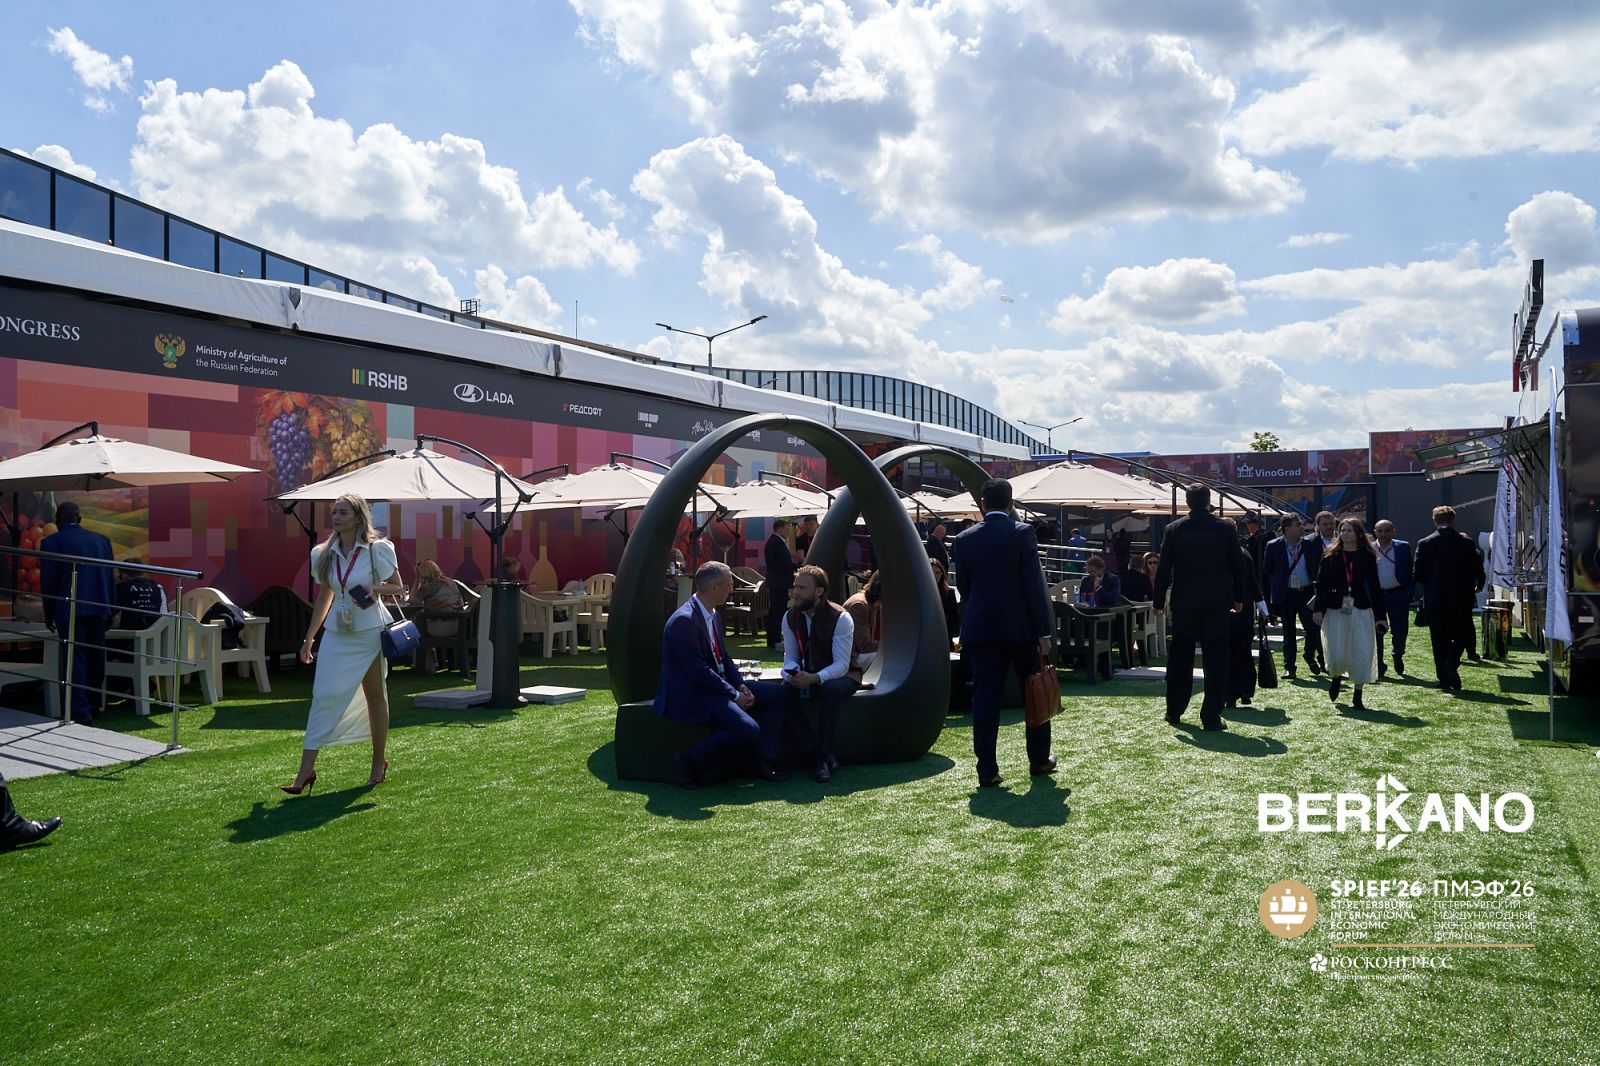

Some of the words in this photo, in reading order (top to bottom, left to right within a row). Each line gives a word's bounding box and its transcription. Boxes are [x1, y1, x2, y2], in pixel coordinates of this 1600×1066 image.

[196, 345, 227, 359] Ministry
[228, 349, 238, 358] of
[238, 352, 278, 364] Agriculture
[279, 357, 288, 365] of
[196, 358, 209, 367] the
[210, 360, 238, 371] Russian
[240, 364, 278, 376] Federation
[368, 371, 408, 391] RSHB
[486, 390, 514, 405] LADA
[569, 403, 602, 416] РЕДСОФТ
[1255, 467, 1302, 478] VinoGrad
